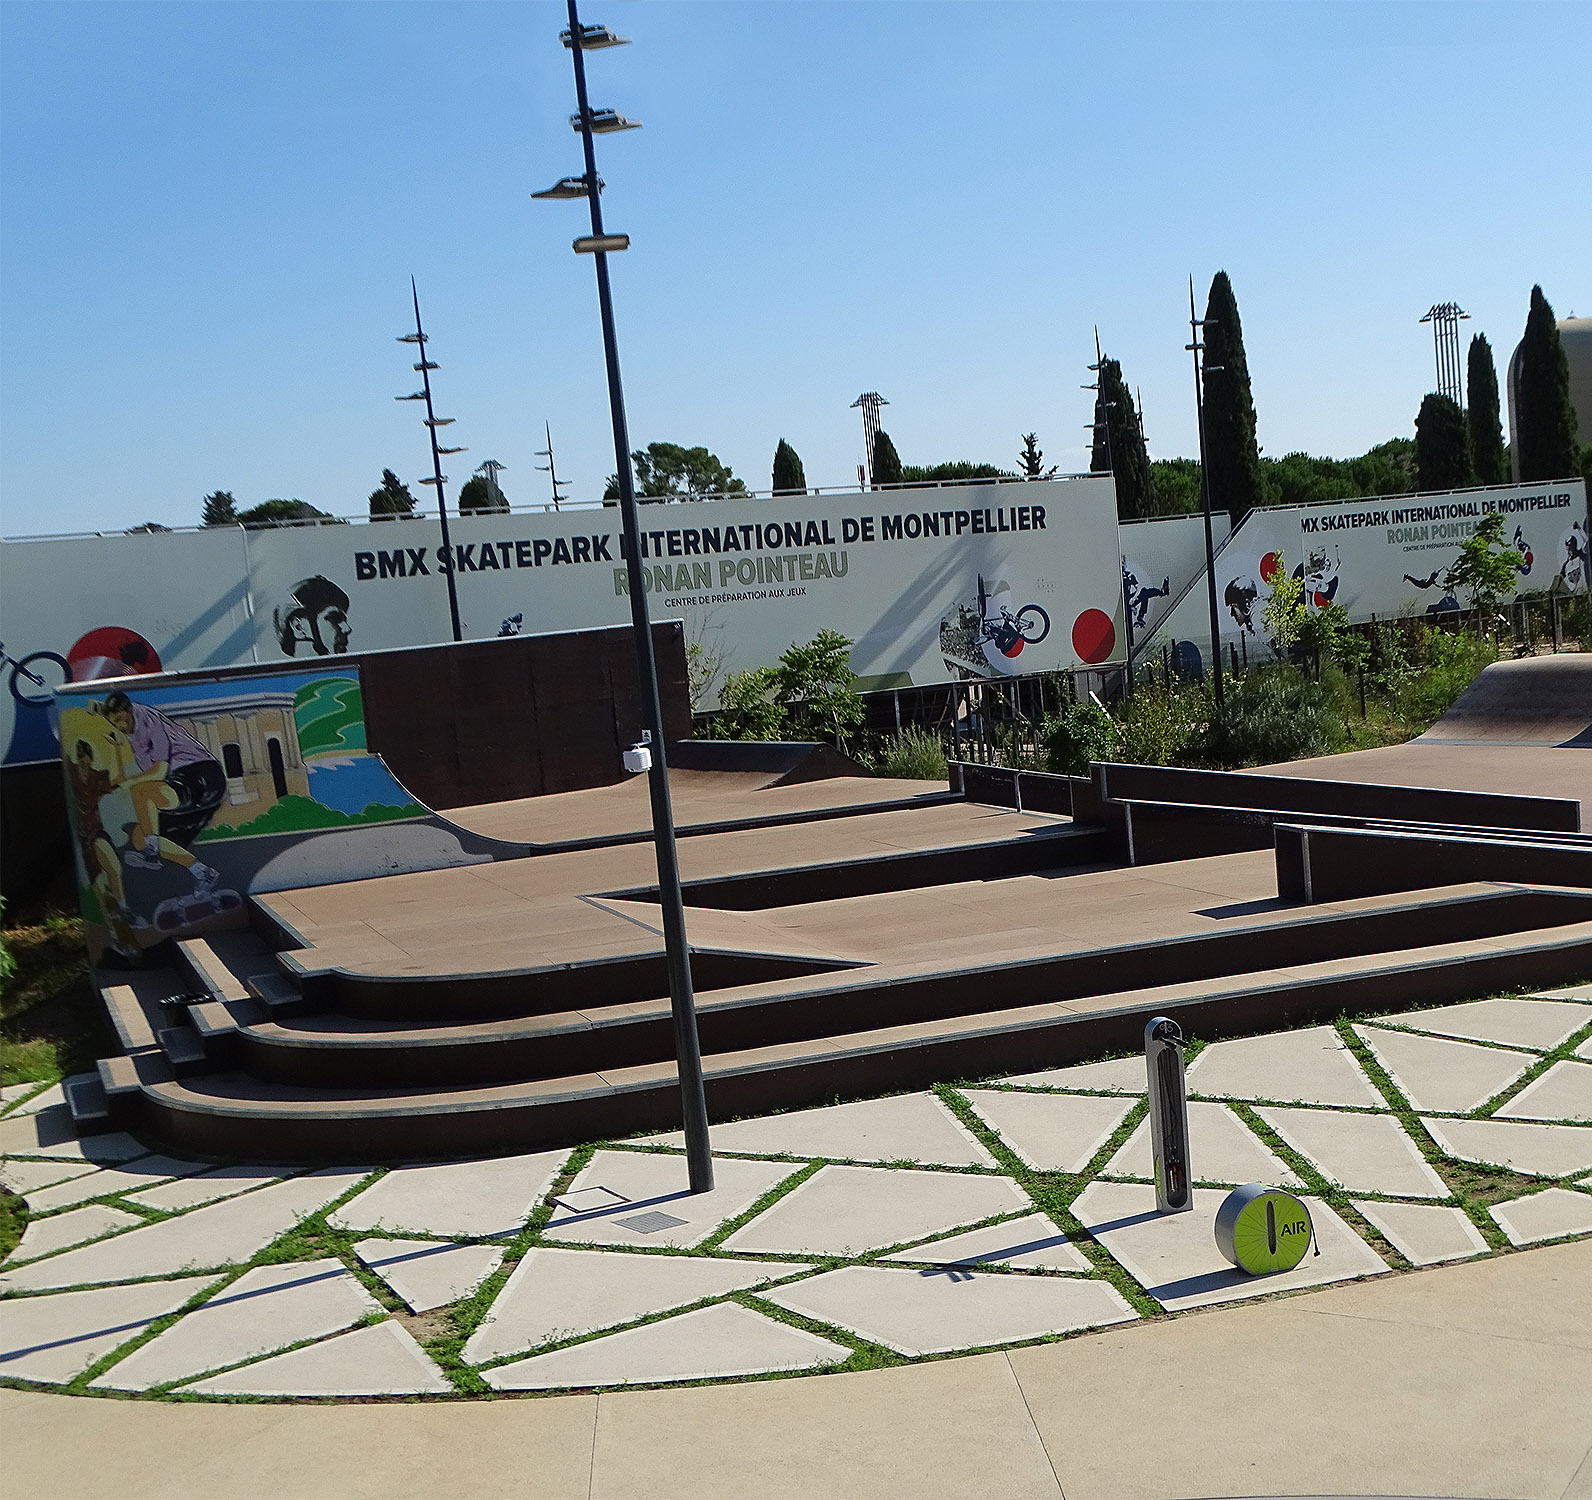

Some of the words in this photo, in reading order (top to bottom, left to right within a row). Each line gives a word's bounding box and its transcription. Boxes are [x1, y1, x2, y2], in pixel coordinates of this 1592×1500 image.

[1321, 510, 1390, 532] SKATEPARK
[1391, 502, 1480, 525] INTERNATIONAL
[1482, 500, 1497, 516] DE
[1499, 493, 1571, 513] MONTPELLIER
[354, 547, 431, 581] BMX
[436, 533, 614, 575] SKATEPARK
[841, 516, 875, 544] DE
[881, 505, 1047, 541] MONTPELLIER
[1387, 525, 1429, 544] RONAN
[1431, 520, 1484, 540] POINTEA
[719, 551, 849, 587] POINTEAU
[664, 596, 697, 608] CENTRE
[698, 595, 710, 605] DE
[711, 590, 767, 603] PRÉPARATION
[769, 588, 785, 598] AUX
[787, 586, 807, 597] JEUX
[1280, 1220, 1307, 1238] AIR
